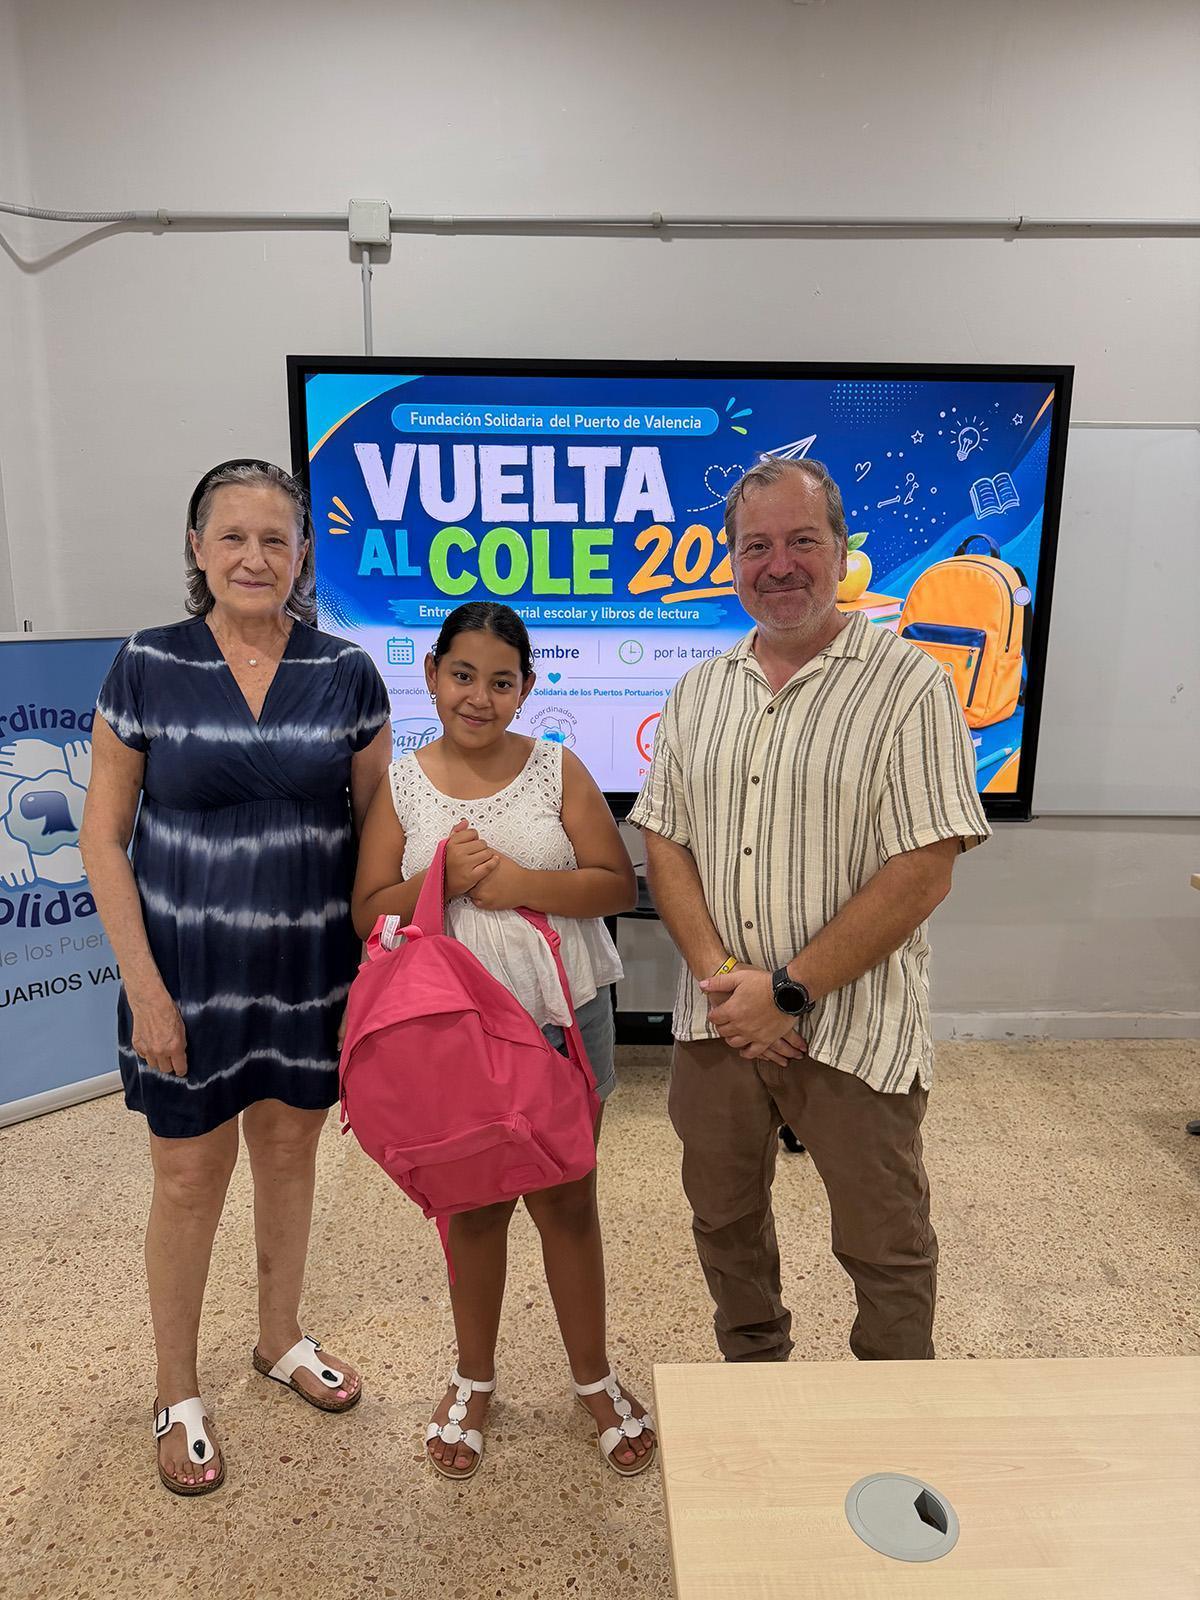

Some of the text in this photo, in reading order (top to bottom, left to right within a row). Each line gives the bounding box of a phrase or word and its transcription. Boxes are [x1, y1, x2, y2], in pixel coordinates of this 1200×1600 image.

[410, 411, 702, 429] Fundación Solidaria del Puerto de Valencia
[353, 442, 676, 523] VUELTA
[357, 528, 422, 577] AL
[428, 526, 614, 596] COLE
[418, 605, 700, 622] Entre erial escolar y libros de lectura
[533, 645, 580, 659] embre
[654, 646, 722, 661] por la tarde
[388, 687, 425, 695] aboración
[533, 688, 568, 696] Solidaria
[569, 688, 579, 696] de
[580, 688, 592, 696] los
[593, 689, 623, 697] Puertos
[624, 689, 664, 697] Portuarios
[529, 705, 578, 725] Coordinadora
[0, 890, 98, 928] olida
[25, 944, 53, 962] los
[60, 932, 107, 954] Puer
